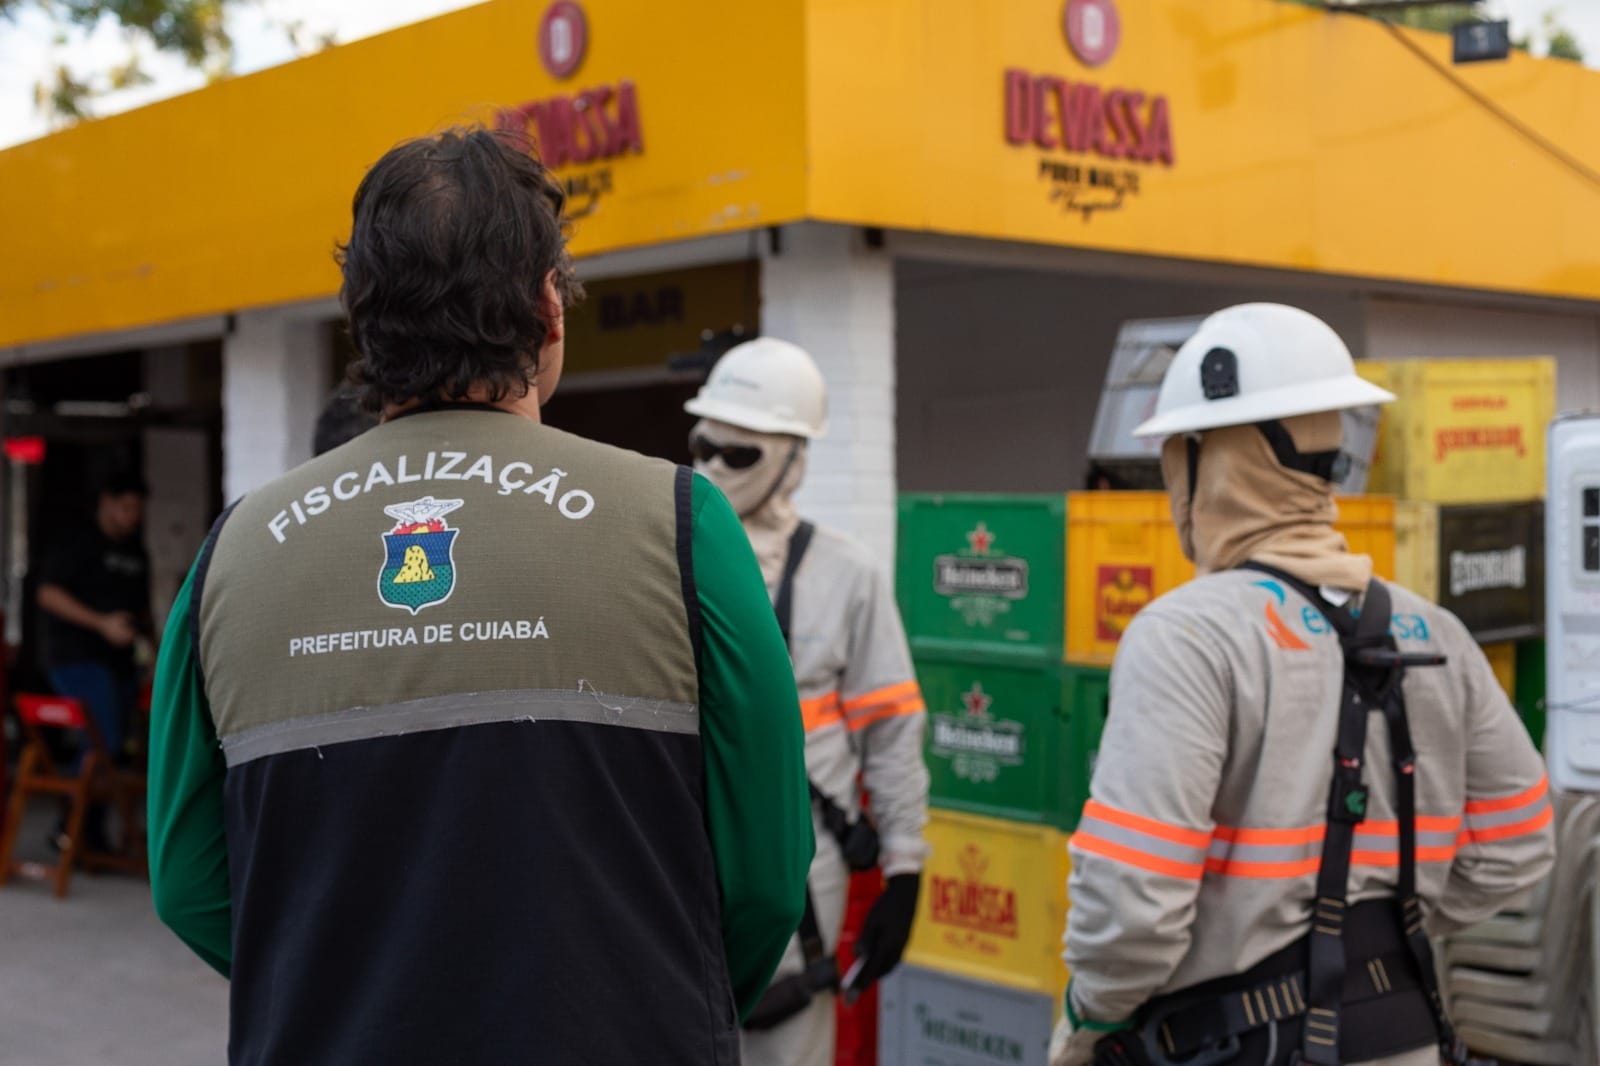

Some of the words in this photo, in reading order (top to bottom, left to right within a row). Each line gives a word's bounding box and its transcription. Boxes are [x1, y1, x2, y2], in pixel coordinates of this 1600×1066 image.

[1004, 67, 1175, 168] DEVASSA
[267, 451, 596, 544] FISCALIZAÇÃO
[289, 626, 418, 657] PREFEITURA
[423, 623, 453, 644] DE
[459, 616, 550, 641] CUIABÁ
